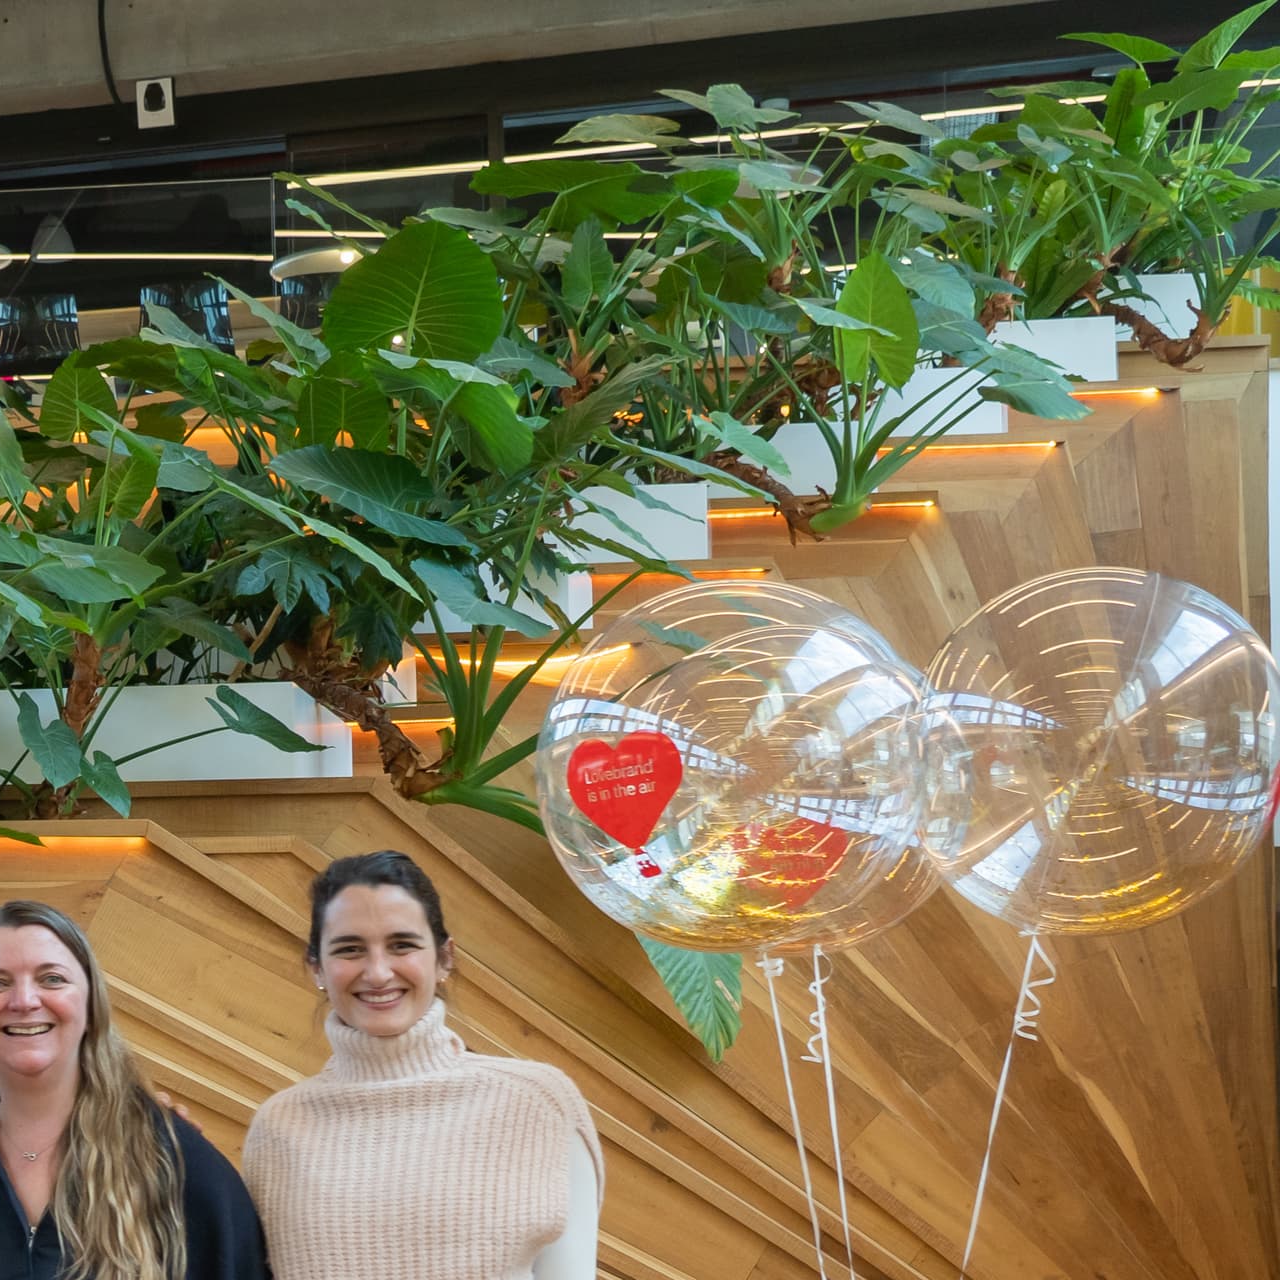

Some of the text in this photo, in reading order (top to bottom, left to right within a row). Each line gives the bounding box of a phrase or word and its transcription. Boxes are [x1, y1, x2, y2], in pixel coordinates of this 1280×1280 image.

[584, 758, 654, 784] Lovebrand
[587, 778, 657, 803] is in the air
